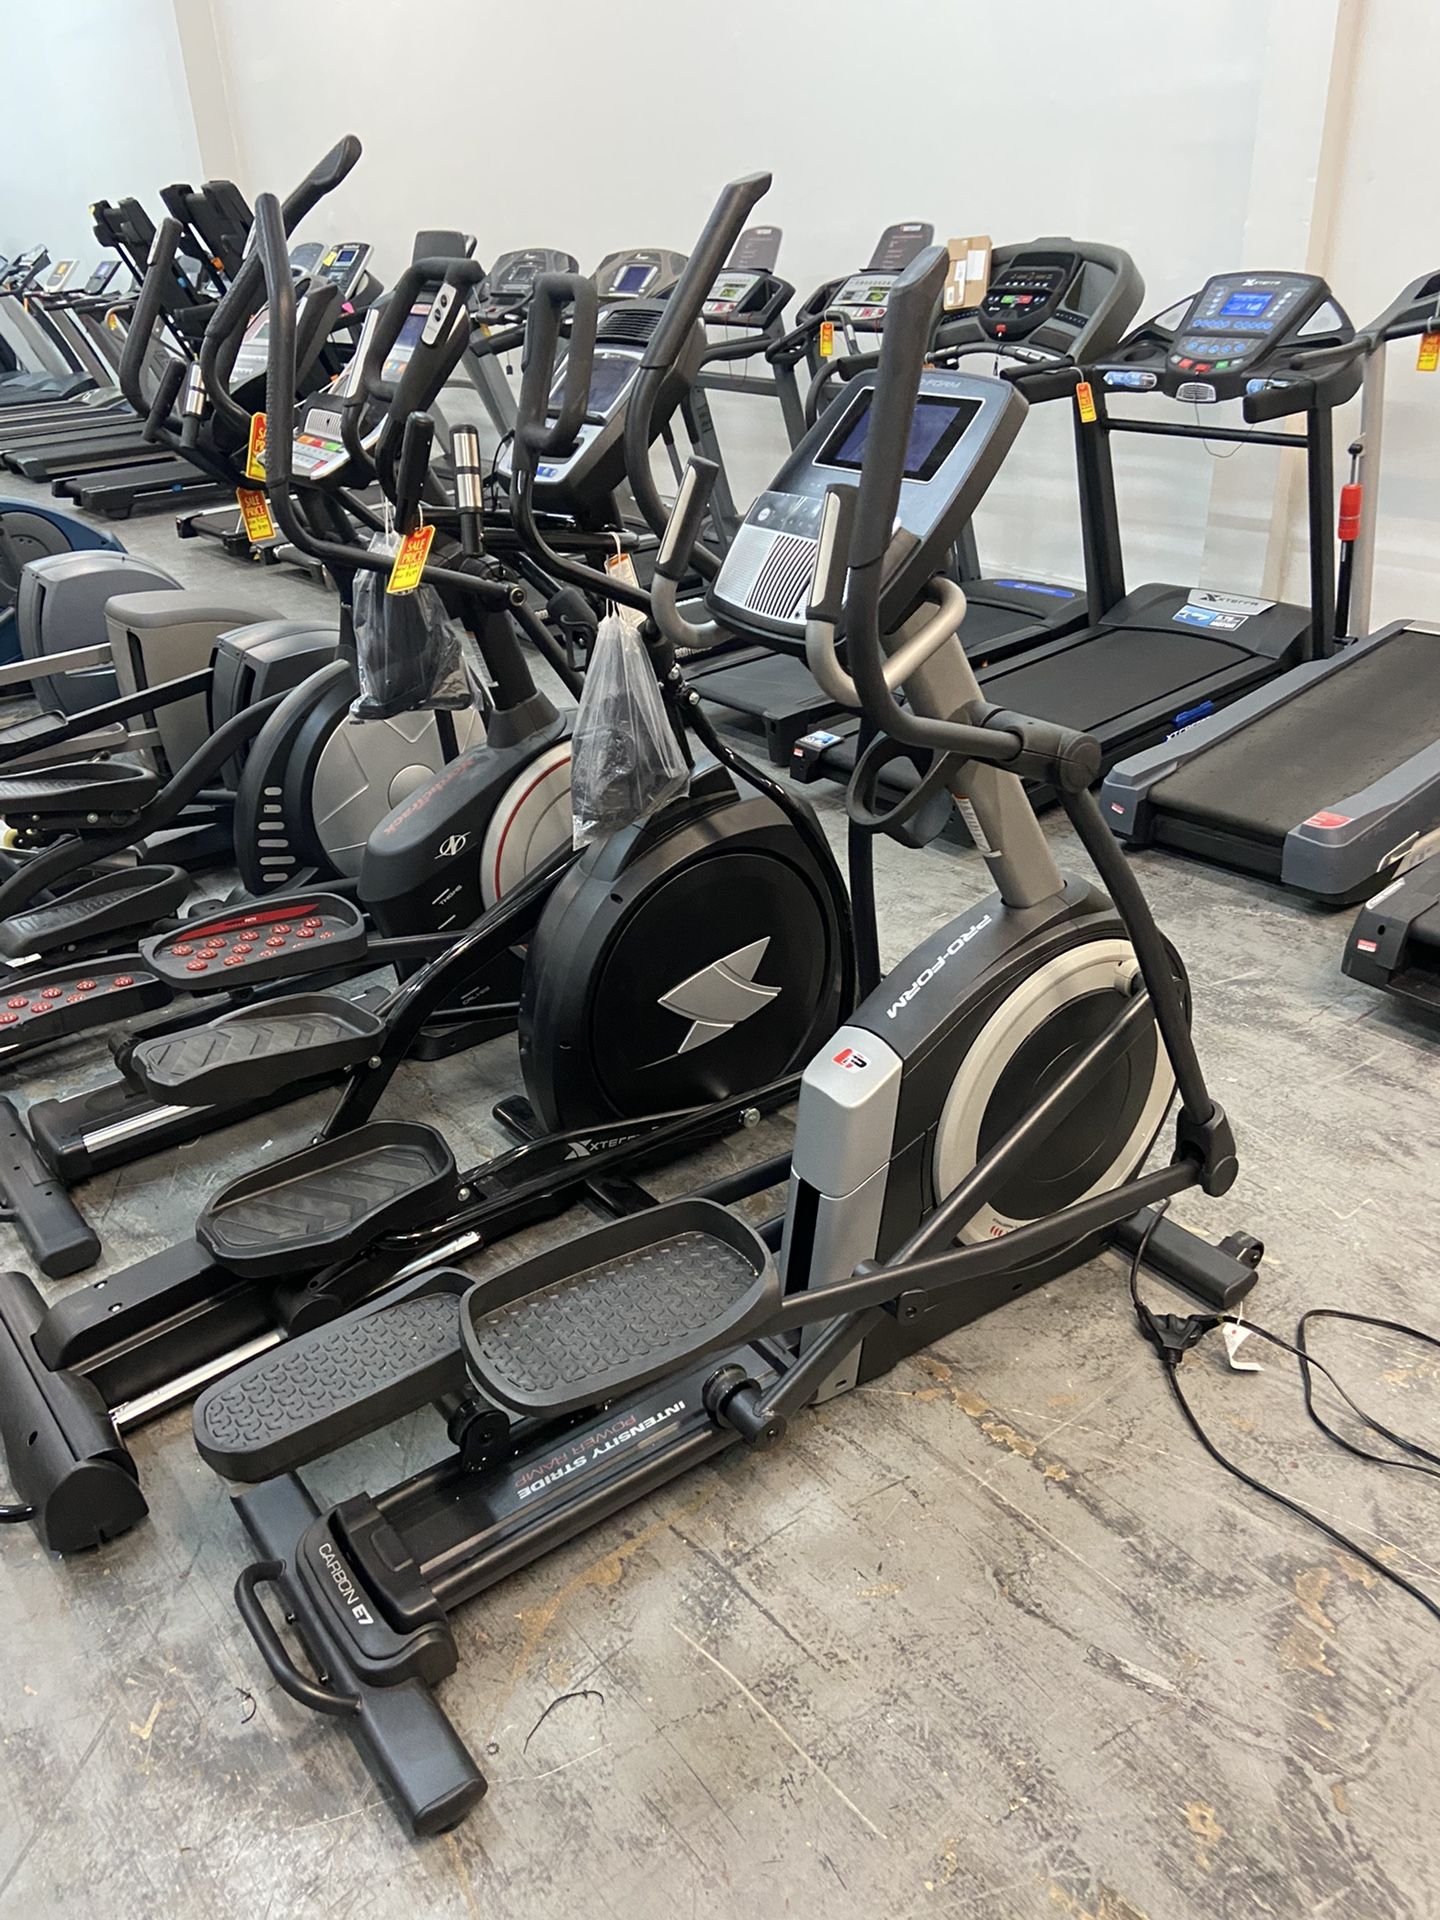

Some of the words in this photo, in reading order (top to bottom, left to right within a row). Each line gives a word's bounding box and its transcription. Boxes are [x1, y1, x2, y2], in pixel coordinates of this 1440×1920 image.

[401, 550, 425, 565] PRICE
[406, 538, 427, 553] SALE
[384, 757, 477, 836] NordicTrack
[886, 914, 993, 1019] PRO-FORM
[572, 1414, 638, 1455] POWER
[592, 1400, 686, 1460] INTENSITY
[515, 1454, 568, 1488] RAMP
[517, 1455, 588, 1500] STRIDE
[318, 1543, 361, 1605] CARBON
[351, 1603, 375, 1625] E7
